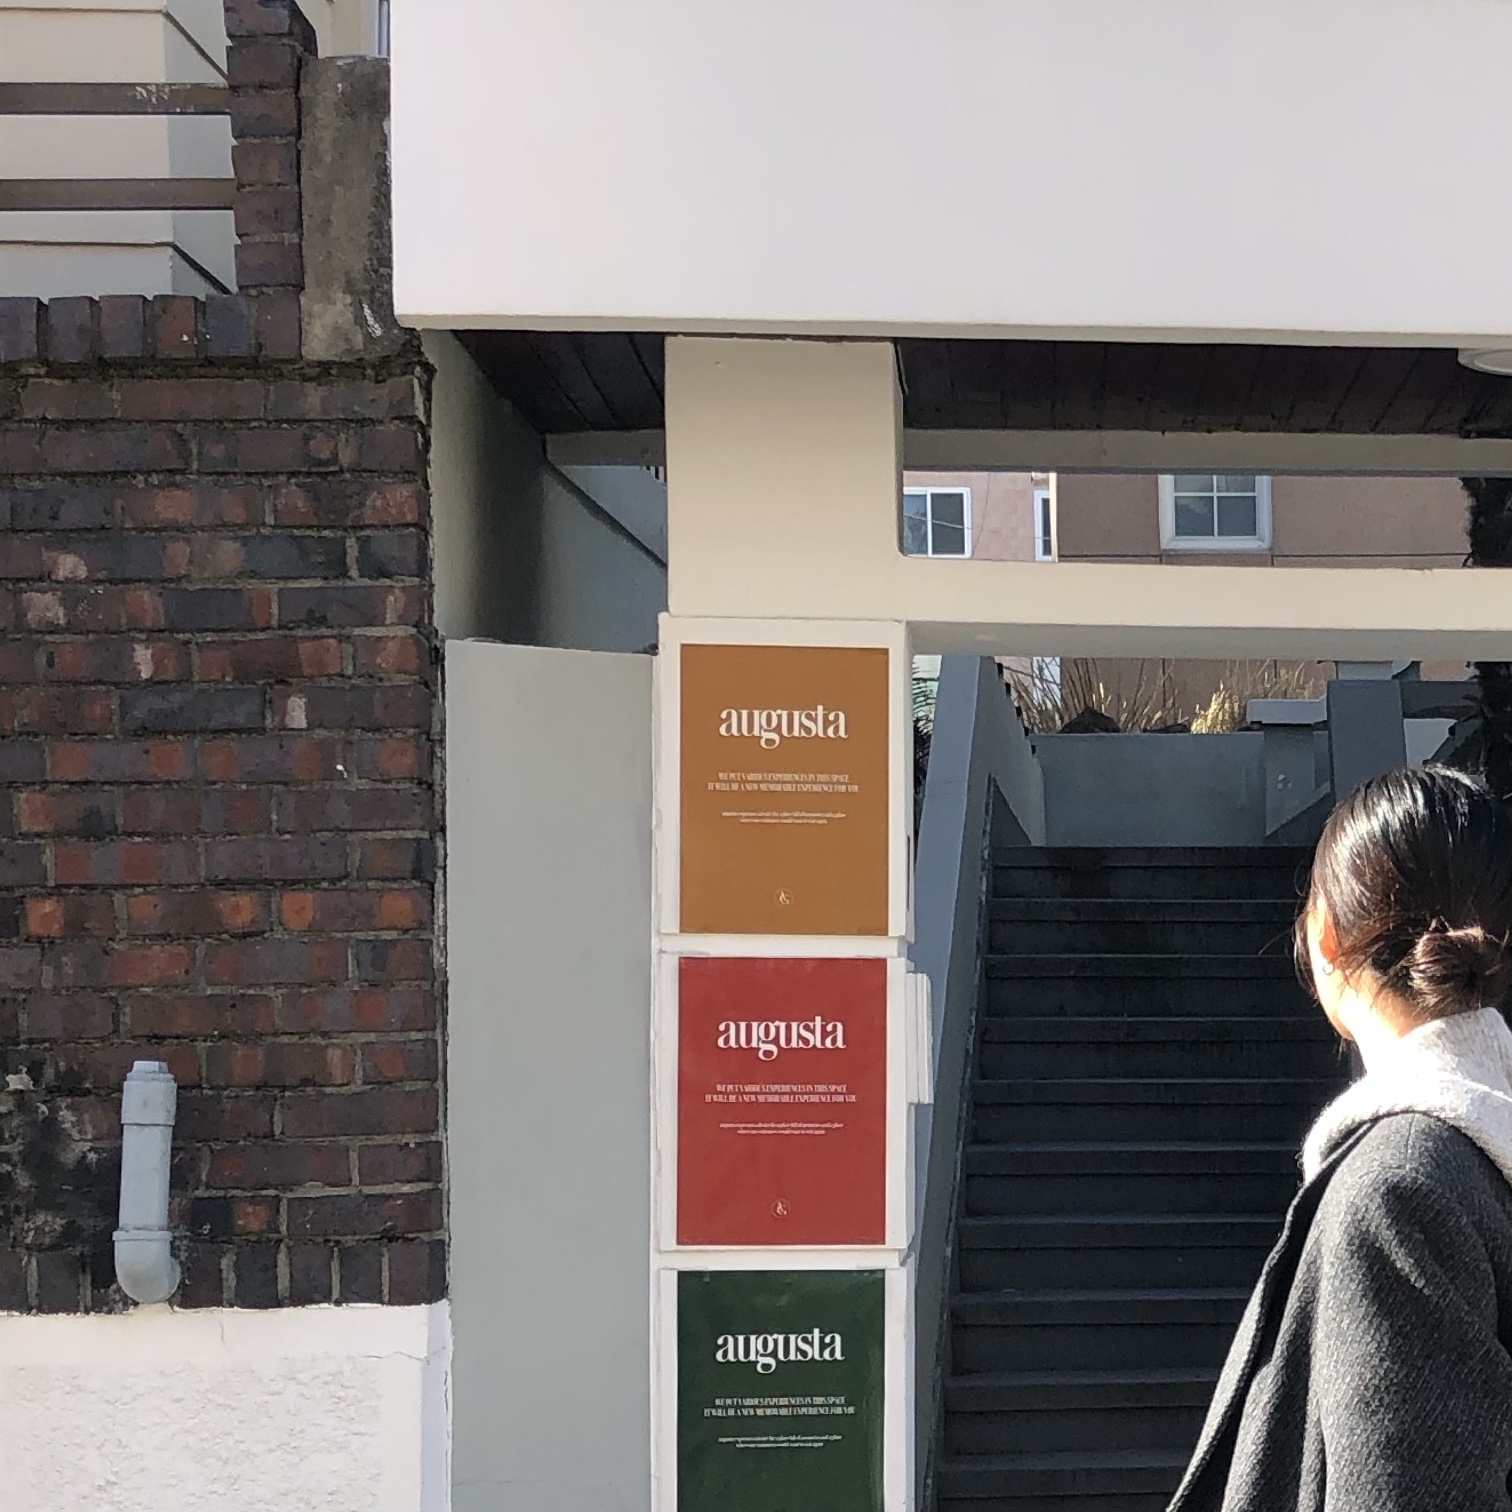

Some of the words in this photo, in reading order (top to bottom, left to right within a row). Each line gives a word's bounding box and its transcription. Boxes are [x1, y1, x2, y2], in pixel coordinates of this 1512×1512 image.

[719, 705, 848, 749] augusta
[718, 1016, 847, 1060] augusta
[716, 1328, 845, 1374] augusta
